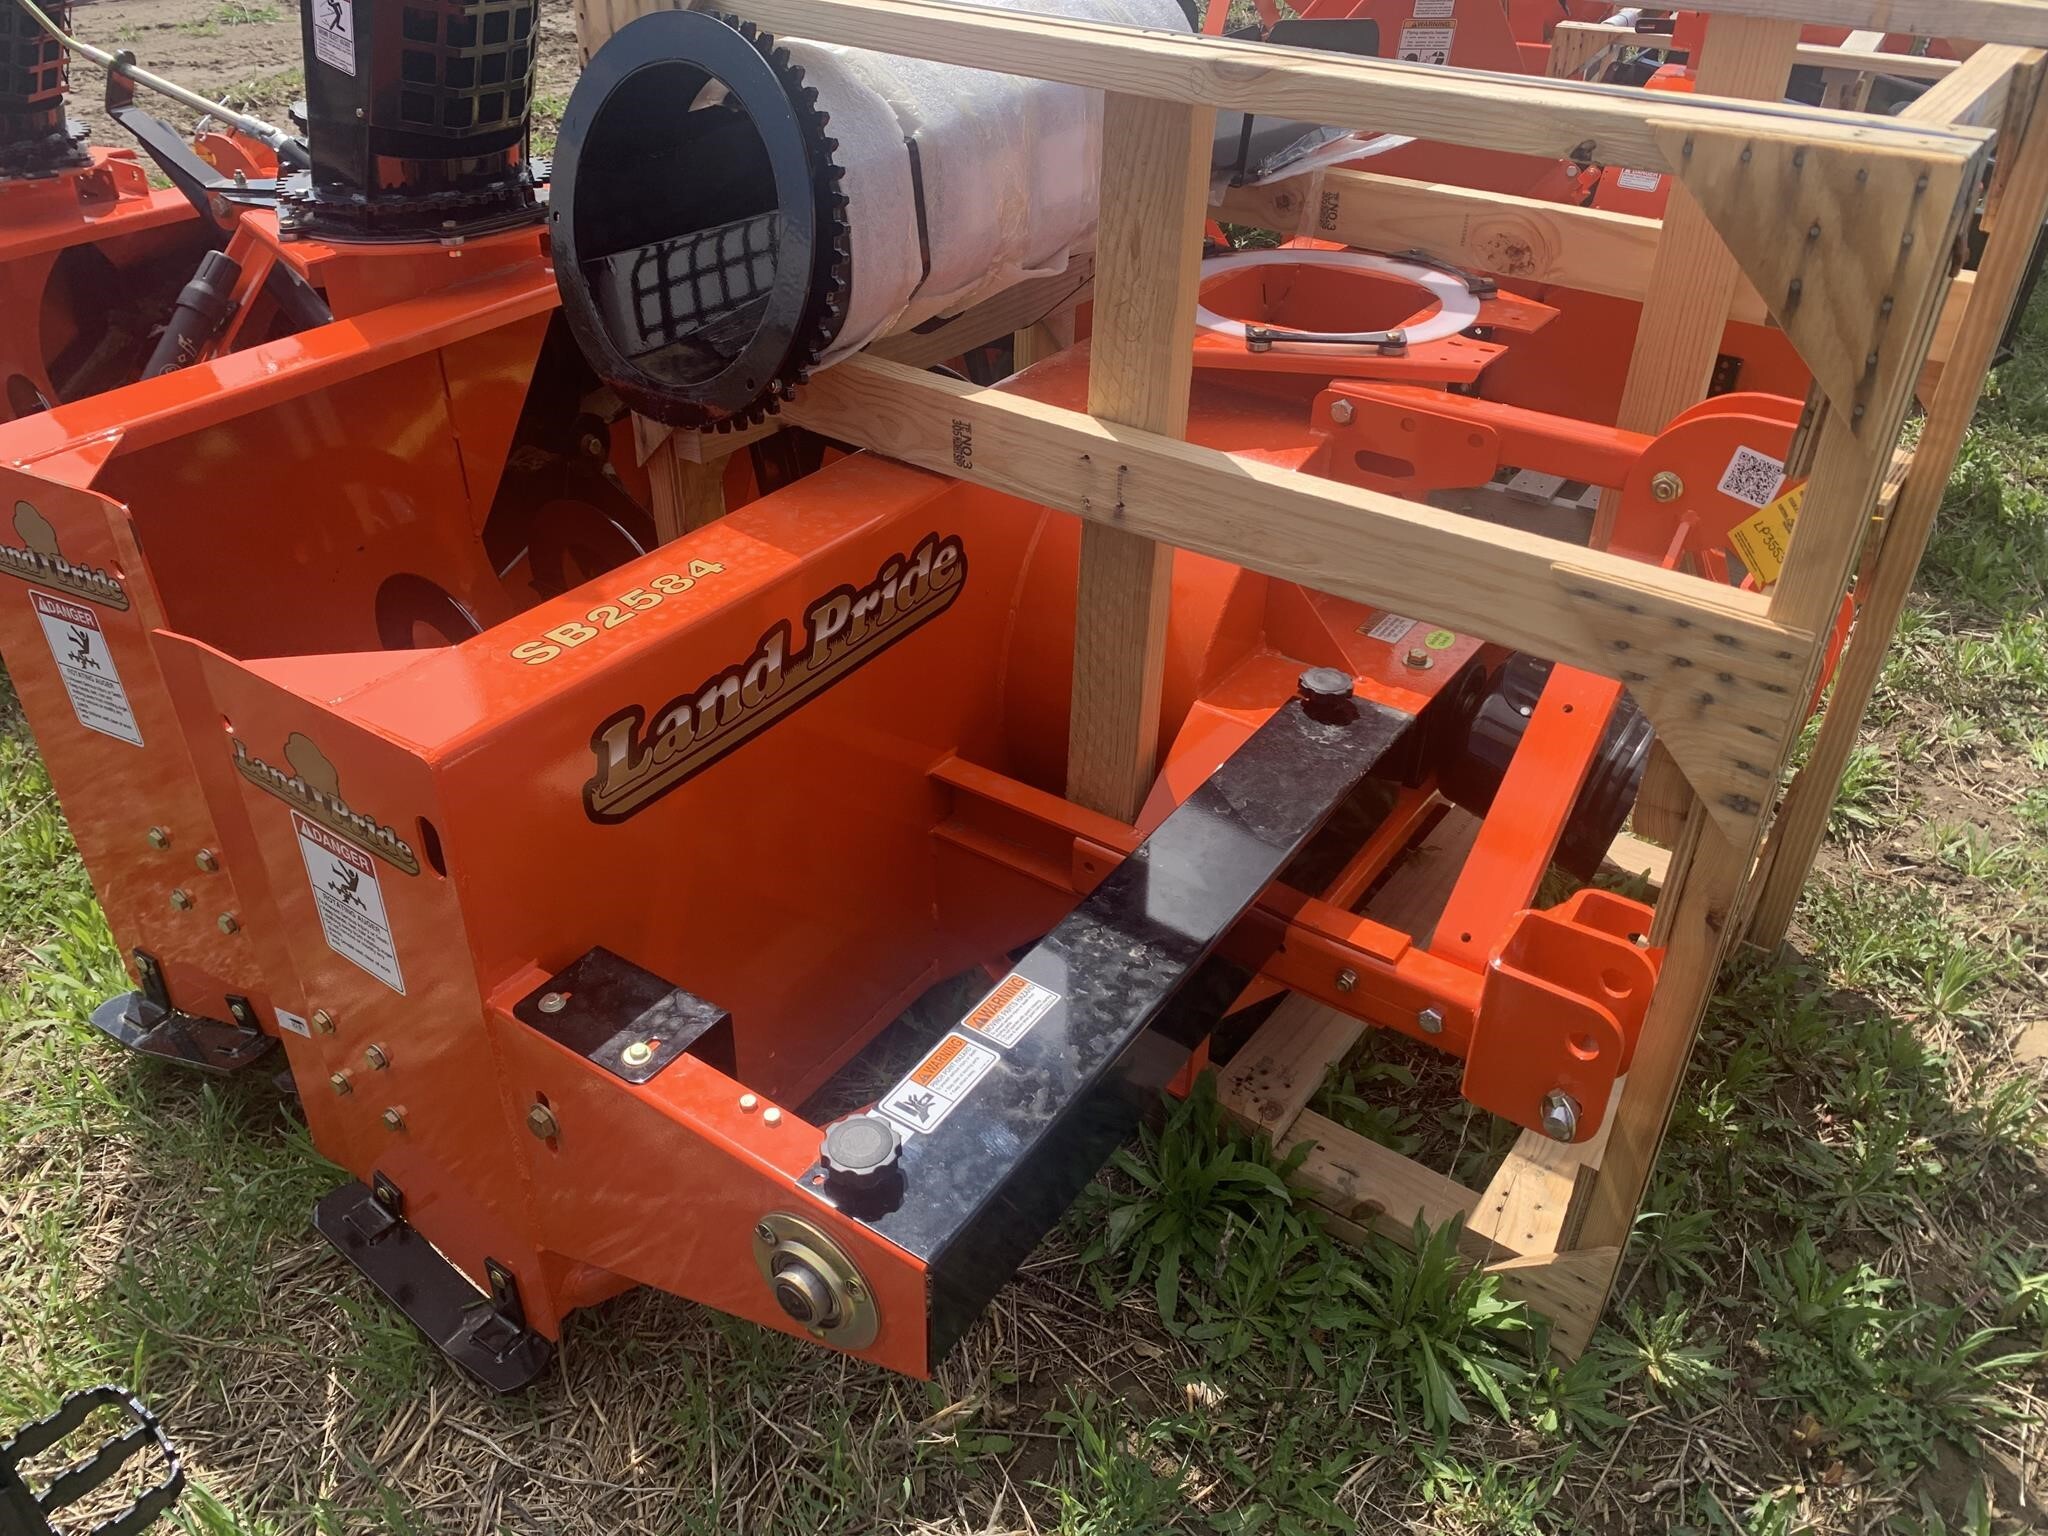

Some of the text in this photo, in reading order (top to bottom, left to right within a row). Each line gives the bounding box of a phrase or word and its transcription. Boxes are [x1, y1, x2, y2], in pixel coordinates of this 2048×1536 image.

[50, 553, 123, 600] Pride
[46, 600, 95, 627] DANGER
[509, 557, 727, 667] SB2584
[599, 541, 962, 799] Land Pride
[234, 739, 415, 864] Land Pride
[312, 828, 370, 872] DANGER
[978, 977, 1026, 1017] WARNING
[923, 1038, 963, 1075] WARNING
